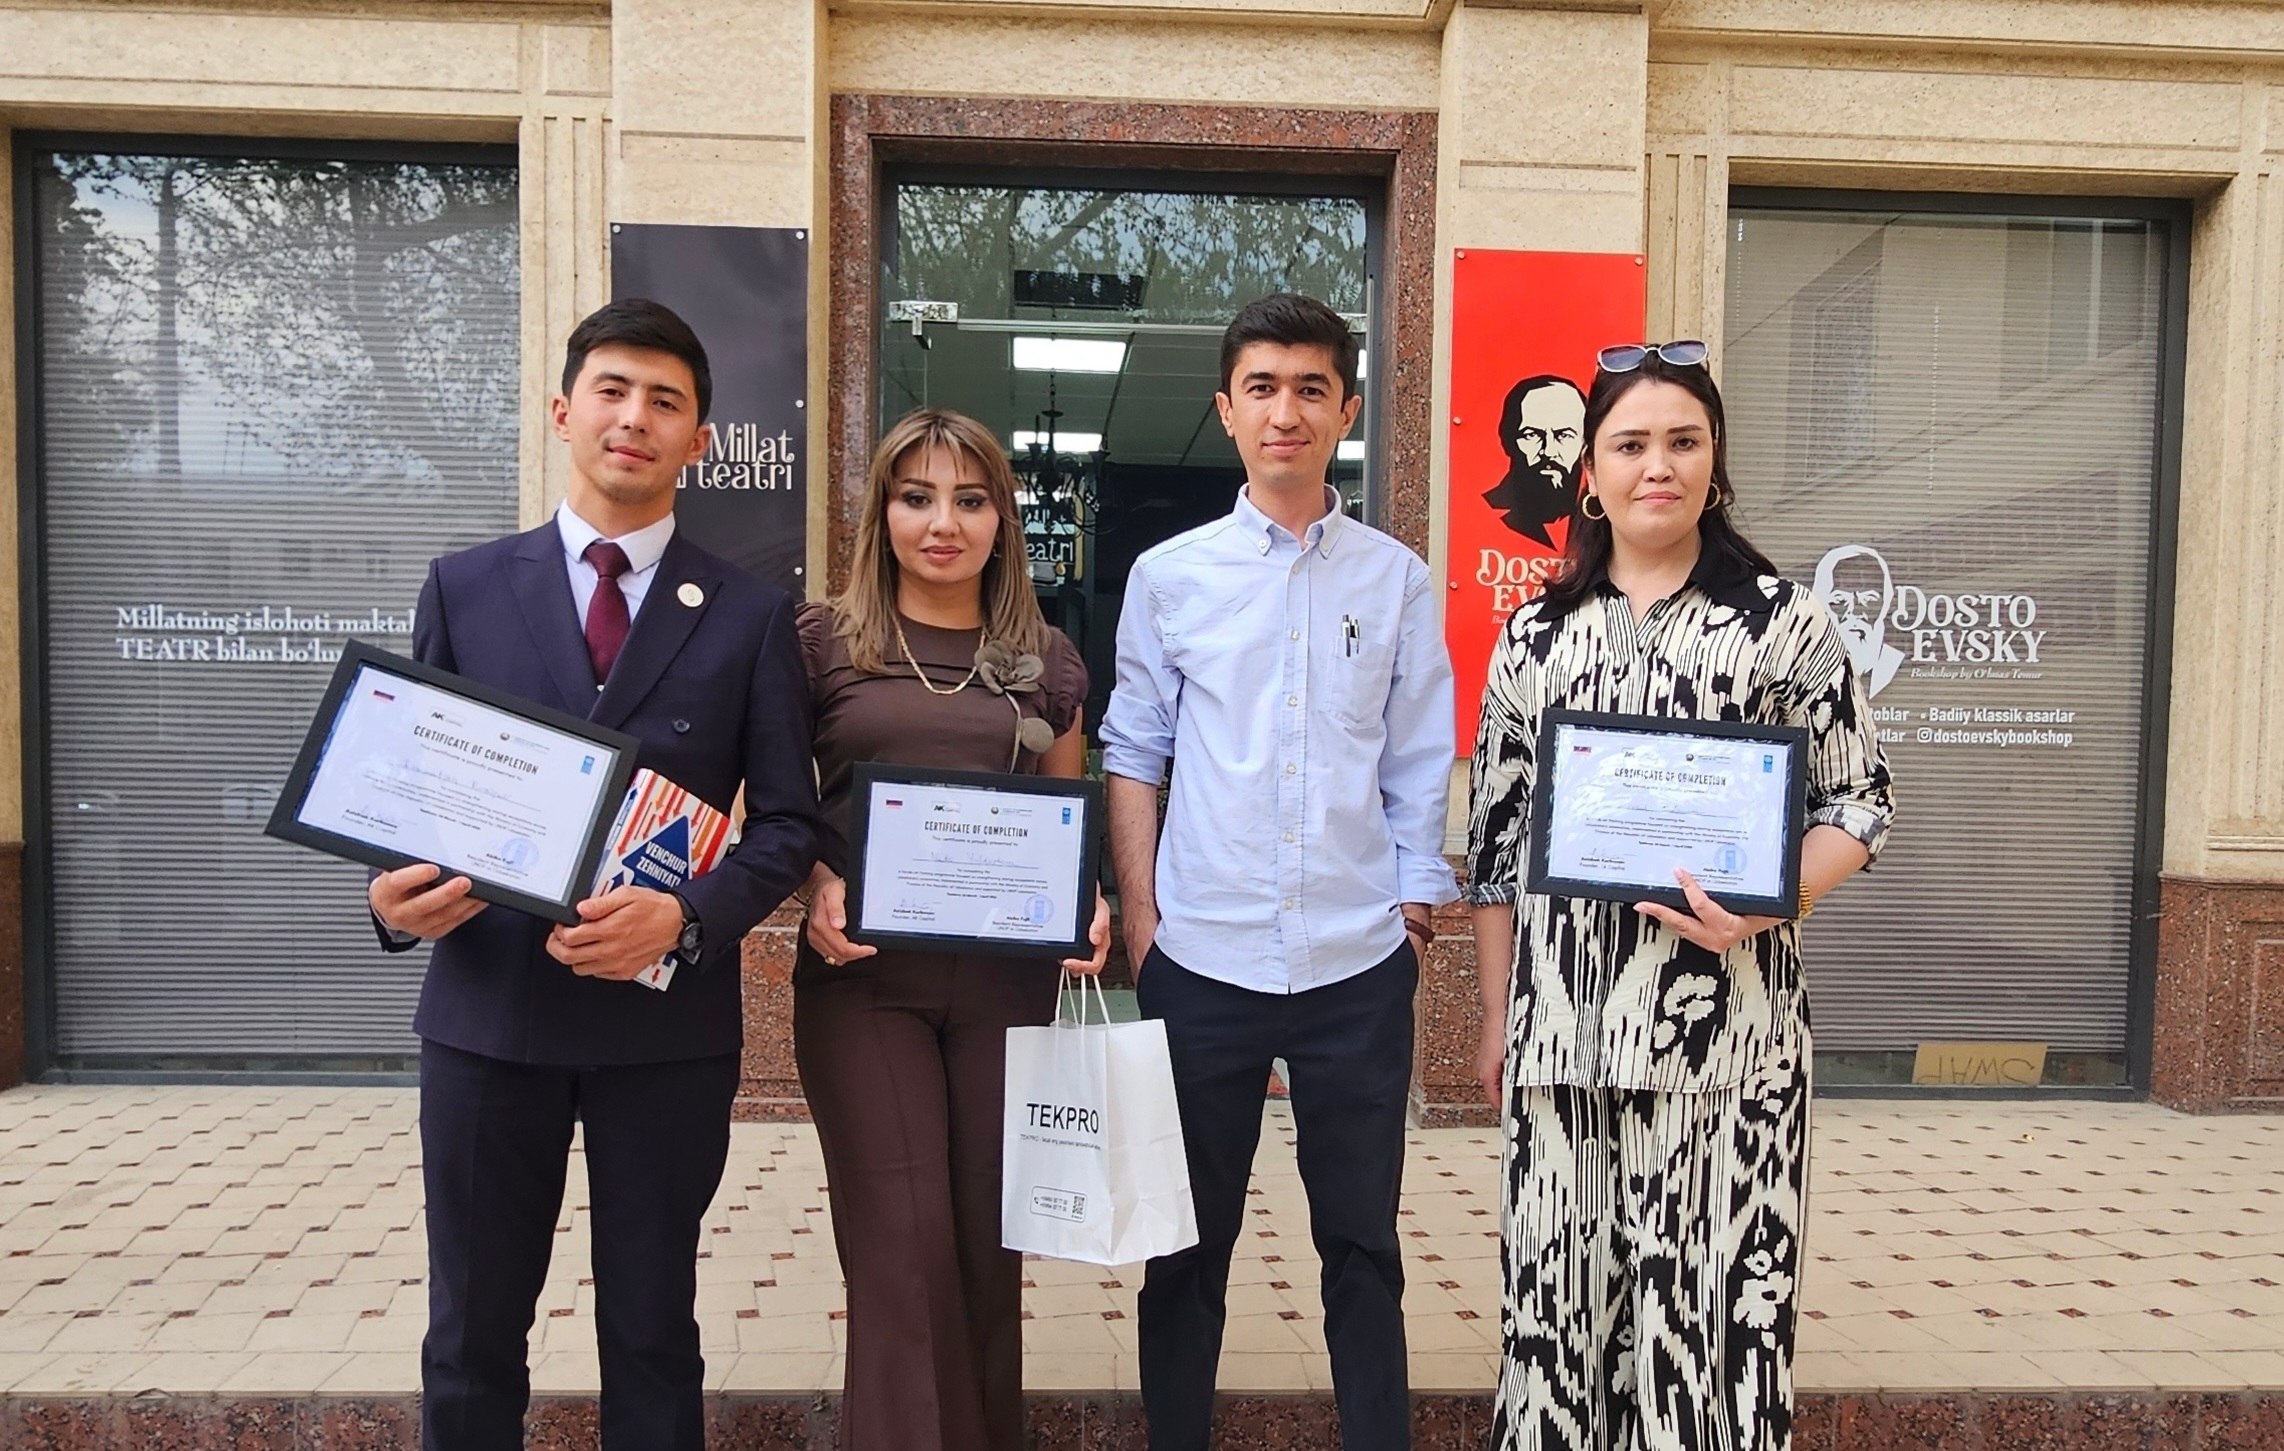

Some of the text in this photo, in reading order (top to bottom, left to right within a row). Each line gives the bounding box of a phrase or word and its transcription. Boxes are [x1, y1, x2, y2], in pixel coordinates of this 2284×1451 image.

[708, 422, 795, 463] Millat
[696, 459, 792, 490] teatri
[1025, 538, 1074, 562] eatri
[116, 604, 239, 634] Millatning
[244, 606, 331, 633] islohoti
[1891, 585, 2036, 631] DOSTO
[115, 637, 211, 661] TEATR
[215, 636, 276, 662] bilan
[1910, 629, 2047, 663] EVSKY
[1960, 666, 1974, 680] by
[1929, 707, 2075, 725] Badiiy klassik asarlar
[413, 724, 470, 752] CERTIFICATE
[470, 744, 483, 756] OF
[483, 748, 540, 776] COMPLETION
[1933, 728, 2073, 747] dostoevskybookshop
[924, 820, 1029, 838] CERTIFICATE OF COMPLETION
[645, 841, 688, 875] VENCHUR
[1026, 1103, 1099, 1135] TEKPRO
